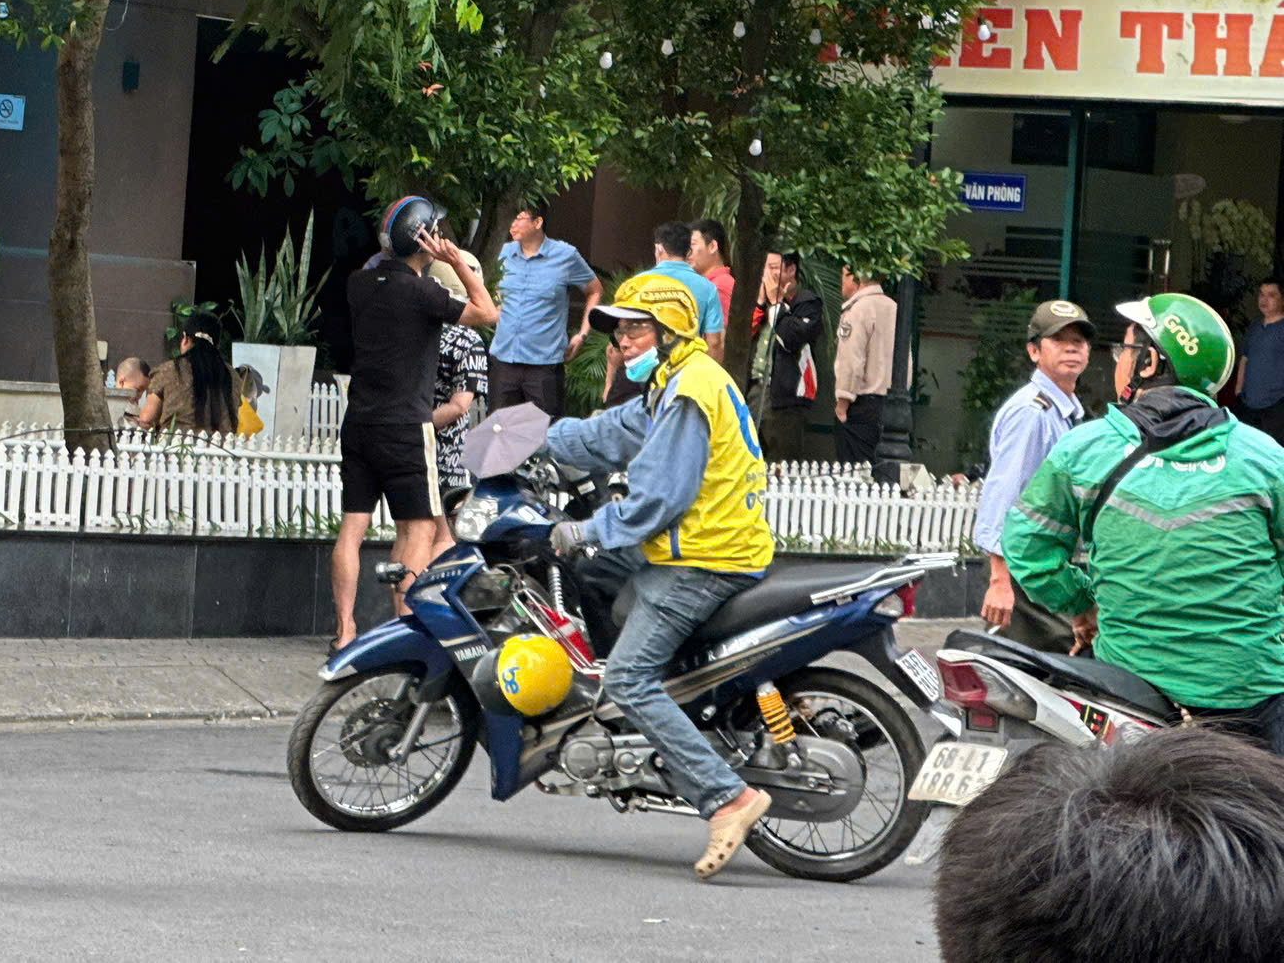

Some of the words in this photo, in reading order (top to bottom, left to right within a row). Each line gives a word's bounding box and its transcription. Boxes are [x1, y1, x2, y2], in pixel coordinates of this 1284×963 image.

[965, 182, 985, 200] VĂN
[987, 183, 1021, 203] PHÒNG
[1164, 315, 1199, 356] Grab
[454, 644, 489, 662] YAMAHA
